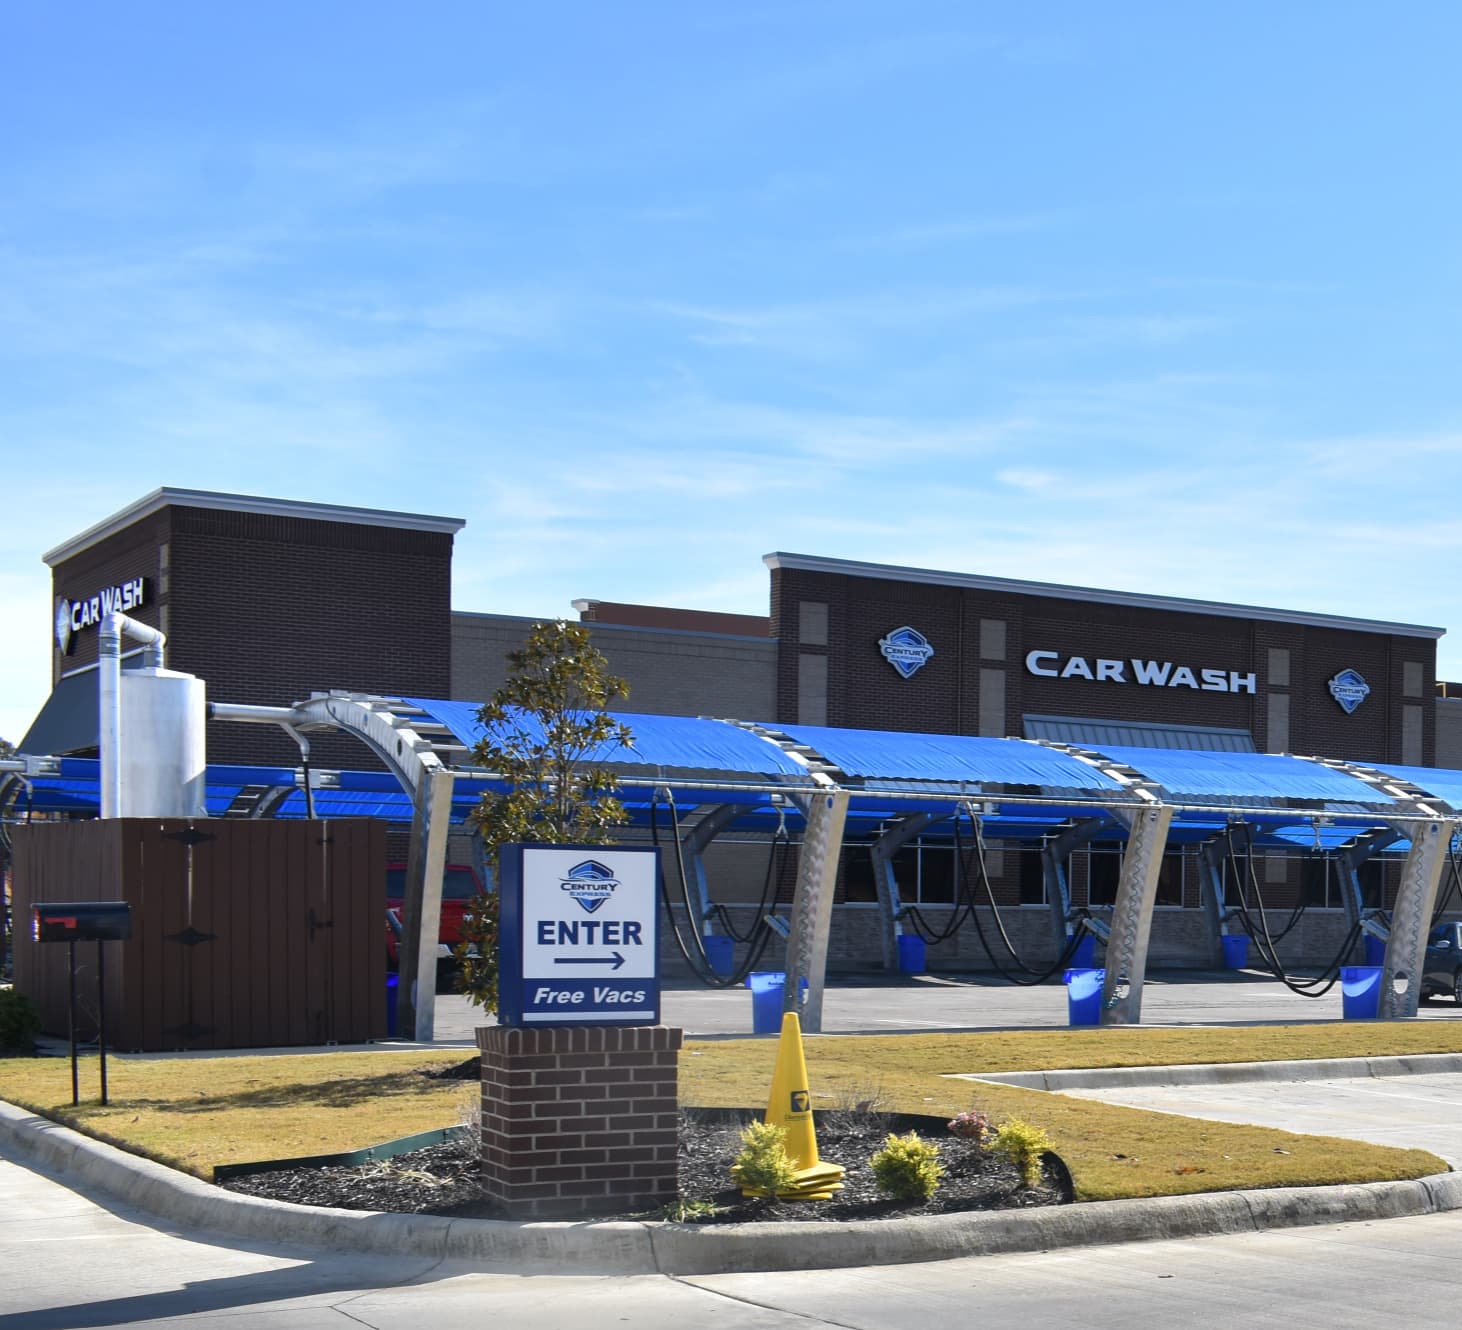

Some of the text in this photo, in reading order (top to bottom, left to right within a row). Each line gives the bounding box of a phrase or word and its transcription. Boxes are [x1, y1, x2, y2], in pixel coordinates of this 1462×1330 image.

[71, 577, 144, 632] CAR WASH
[1025, 650, 1257, 694] CAR WASH
[560, 882, 618, 891] CENTURY
[537, 920, 643, 946] ENTER
[533, 987, 646, 1004] Free Vacs
